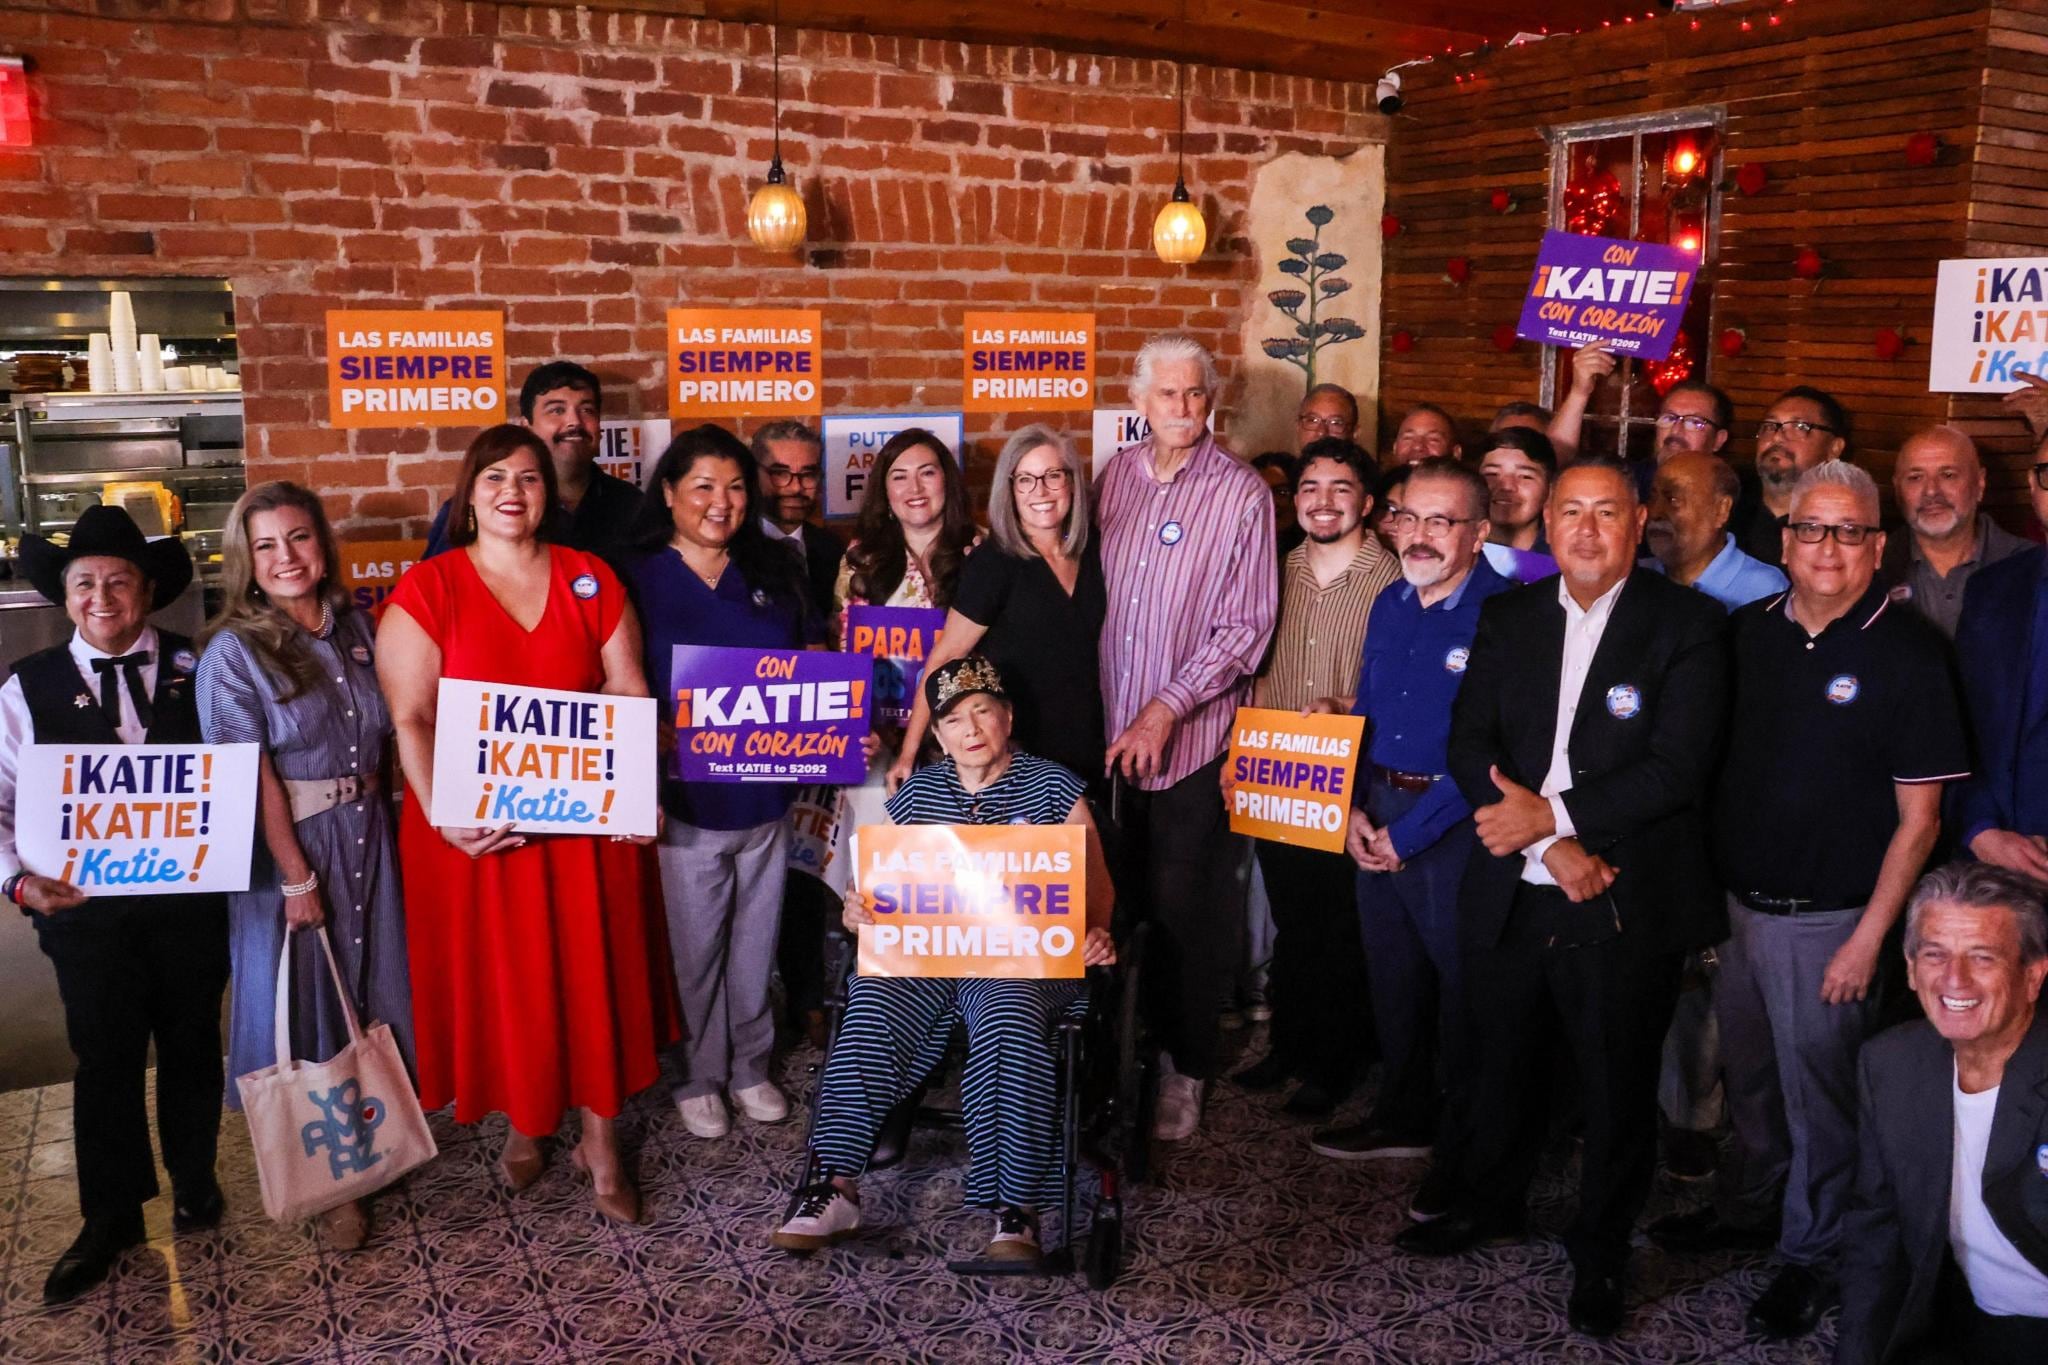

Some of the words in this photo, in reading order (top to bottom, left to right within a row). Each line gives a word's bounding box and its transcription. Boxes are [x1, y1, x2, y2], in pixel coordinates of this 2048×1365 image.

[1602, 244, 1639, 267] CON
[1532, 265, 1690, 305] ¡KATIE!
[1538, 301, 1577, 325] CON
[1579, 305, 1666, 338] CORAZÓN
[1548, 326, 1568, 338] Text
[338, 331, 383, 348] LAS
[388, 331, 494, 348] FAMILIAS
[677, 328, 717, 344] LAS
[721, 328, 813, 344] FAMILIAS
[972, 329, 1005, 344] LAS
[1009, 330, 1088, 345] FAMILIAS
[339, 355, 493, 380] SIEMPRE
[678, 350, 812, 373] SIEMPRE
[972, 350, 1086, 371] SIEMPRE
[341, 386, 498, 413] PRIMERO
[679, 379, 815, 403] PRIMERO
[972, 377, 1089, 399] PRIMERO
[351, 561, 395, 579] LAS
[853, 625, 924, 662] PARA
[755, 655, 798, 680] CON
[479, 692, 615, 741] ¡KATIE!
[675, 680, 866, 729] ¡KATIE!
[880, 707, 905, 717] TEXT
[690, 731, 737, 758] CON
[744, 726, 849, 759] CORAZÓN
[1238, 728, 1269, 749] LAS
[1271, 732, 1352, 758] FAMILIAS
[477, 738, 615, 782] ¡KATIE!
[708, 762, 733, 774] Text
[736, 762, 772, 774] KATIE
[774, 763, 787, 774] to
[789, 763, 827, 775] 52092
[62, 754, 213, 795] ¡KATIE!
[1234, 755, 1345, 795] SIEMPRE
[475, 782, 615, 825] ¡Katie!
[1235, 790, 1343, 833] PRIMERO
[60, 801, 211, 841] ¡KATIE!
[59, 844, 209, 887] ¡Katie!
[872, 851, 924, 873] LAS
[934, 851, 1072, 873] FAMILIAS
[873, 925, 1075, 957] PRIMERO
